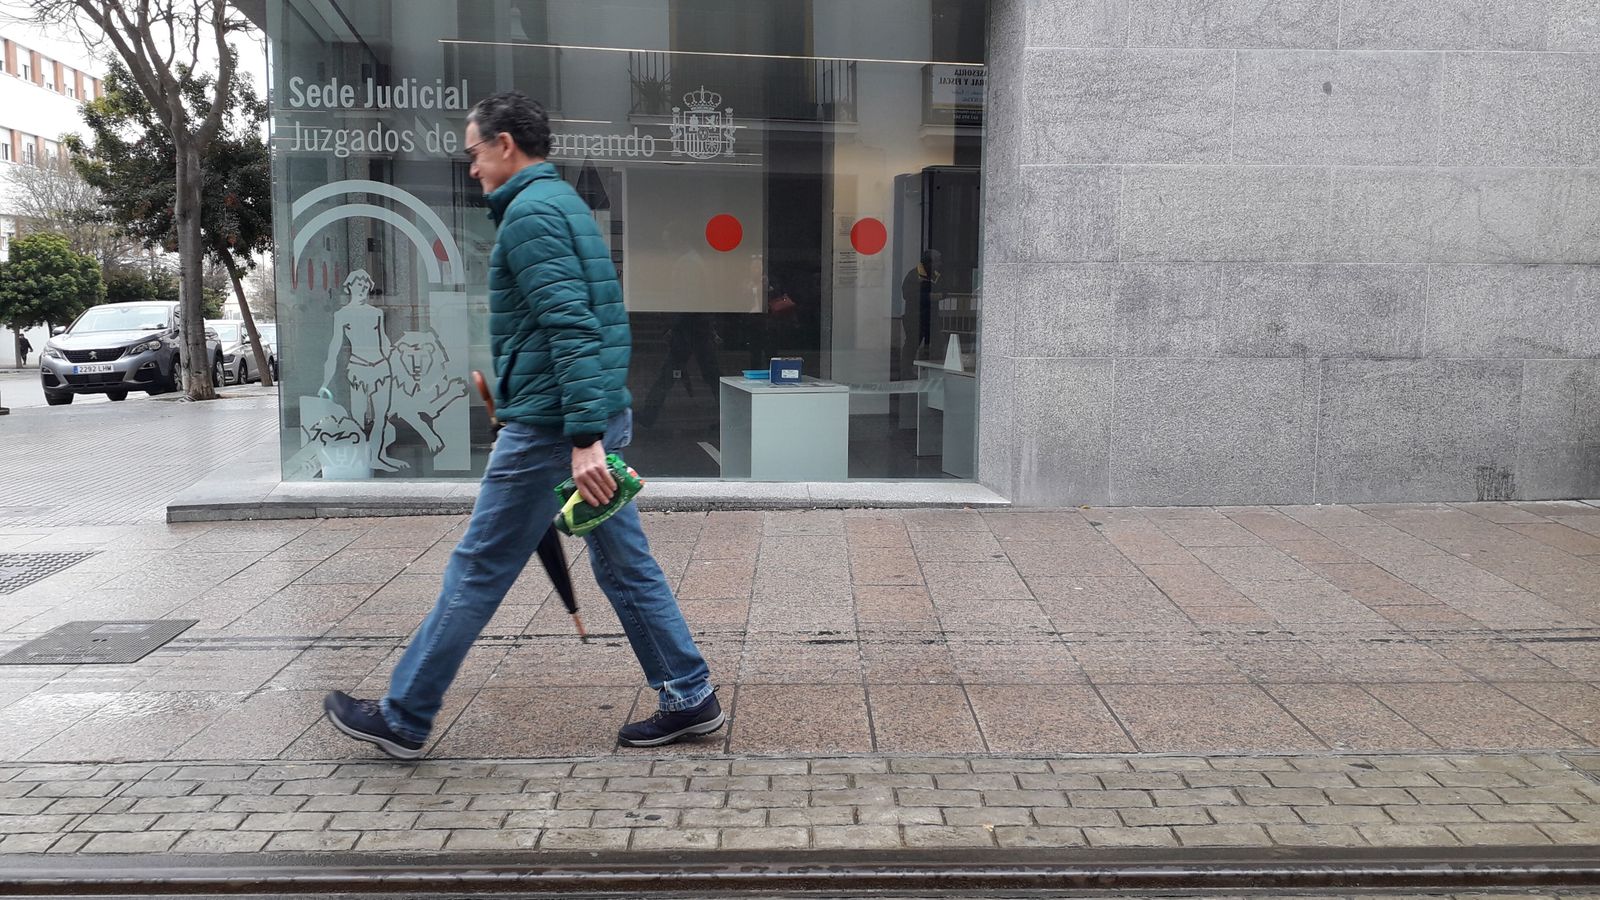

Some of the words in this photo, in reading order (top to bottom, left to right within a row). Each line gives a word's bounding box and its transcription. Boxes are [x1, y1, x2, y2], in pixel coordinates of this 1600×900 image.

[289, 76, 355, 108] Sede
[364, 77, 468, 110] Judicial
[291, 121, 415, 158] Juzgados
[425, 122, 457, 153] de
[549, 126, 655, 157] ernando
